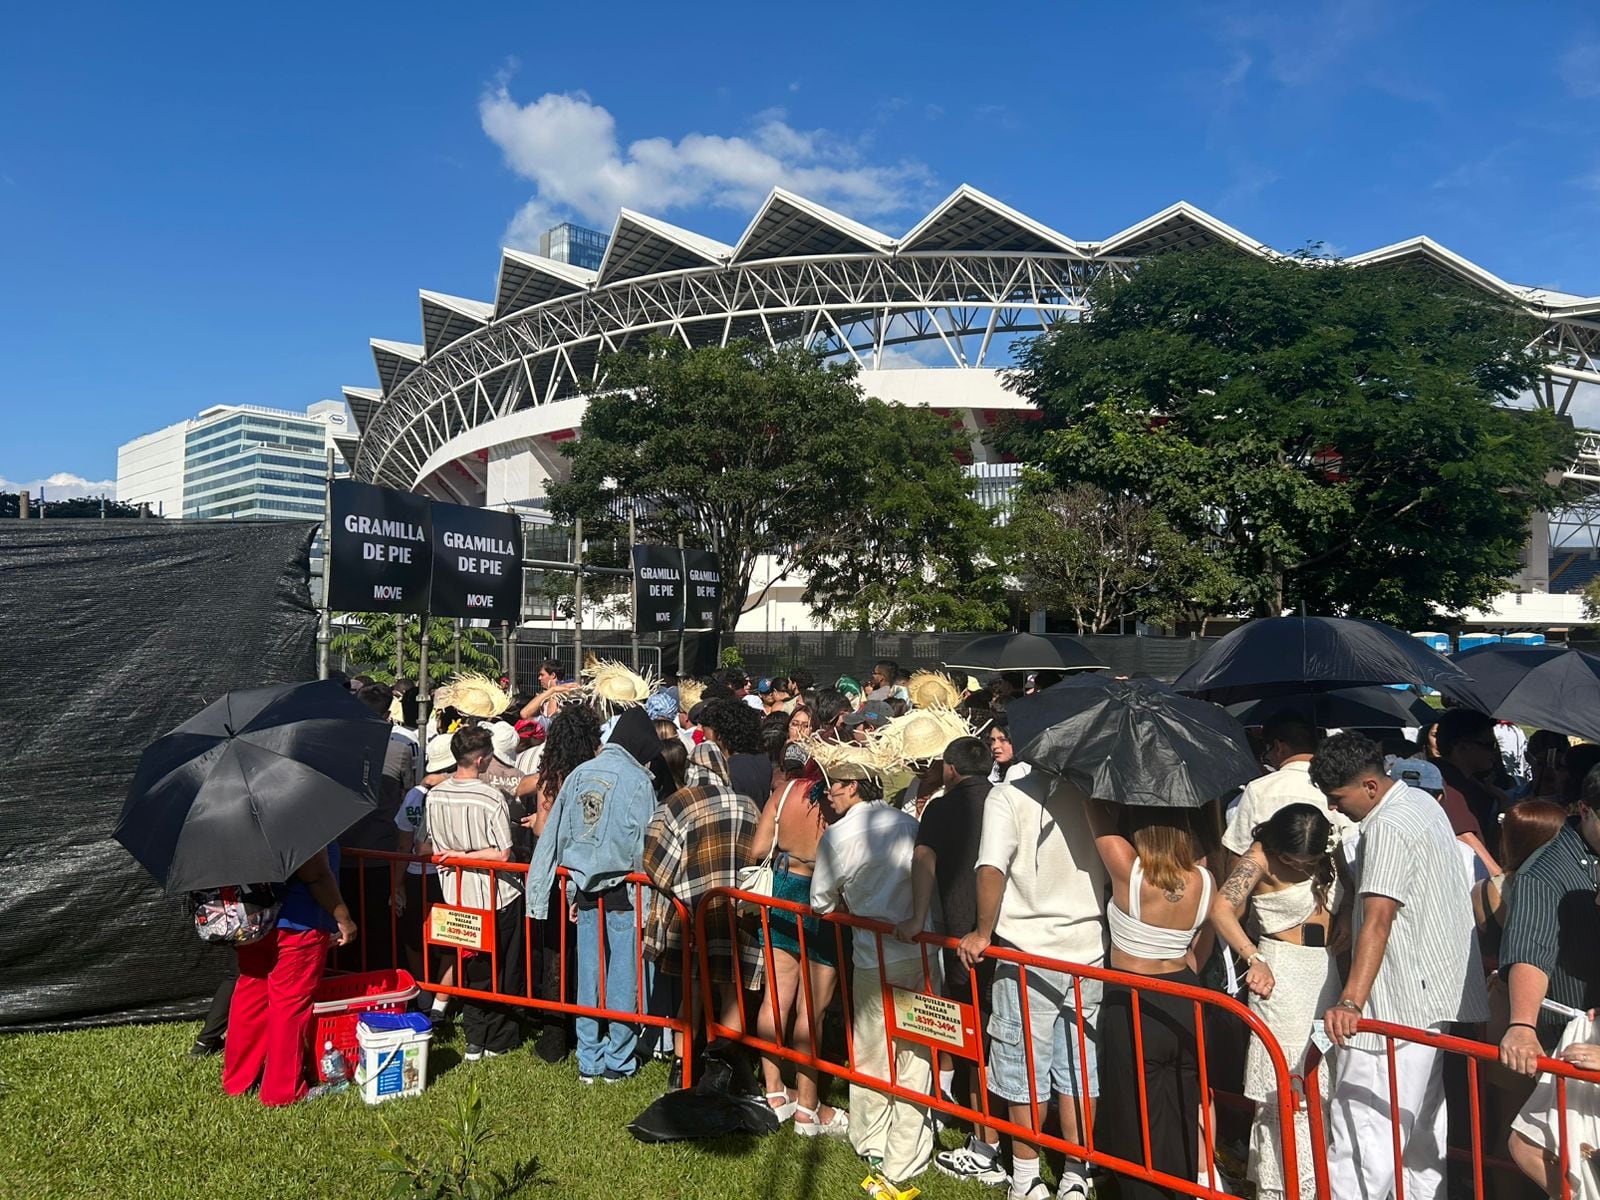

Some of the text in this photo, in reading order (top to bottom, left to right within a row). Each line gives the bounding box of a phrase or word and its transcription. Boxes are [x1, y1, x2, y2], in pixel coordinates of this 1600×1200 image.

[345, 514, 425, 542] GRAMILLA
[443, 531, 514, 556] GRAMILLA
[363, 542, 412, 564] DE PIE
[458, 556, 502, 575] DE PIE
[640, 568, 680, 580] GRAMILLA
[690, 570, 720, 582] GRAMILLA
[374, 585, 402, 600] MOVE
[650, 585, 674, 596] DE PIE
[697, 586, 716, 597] DE PIE
[467, 594, 493, 607] MOVE
[656, 612, 670, 621] MOVE
[702, 612, 712, 620] MOVE
[447, 921, 480, 931] PERIMETRALES
[915, 995, 945, 1007] ALQUILER
[924, 1004, 947, 1014] VALLAS
[914, 1008, 960, 1024] PERIMETRALES
